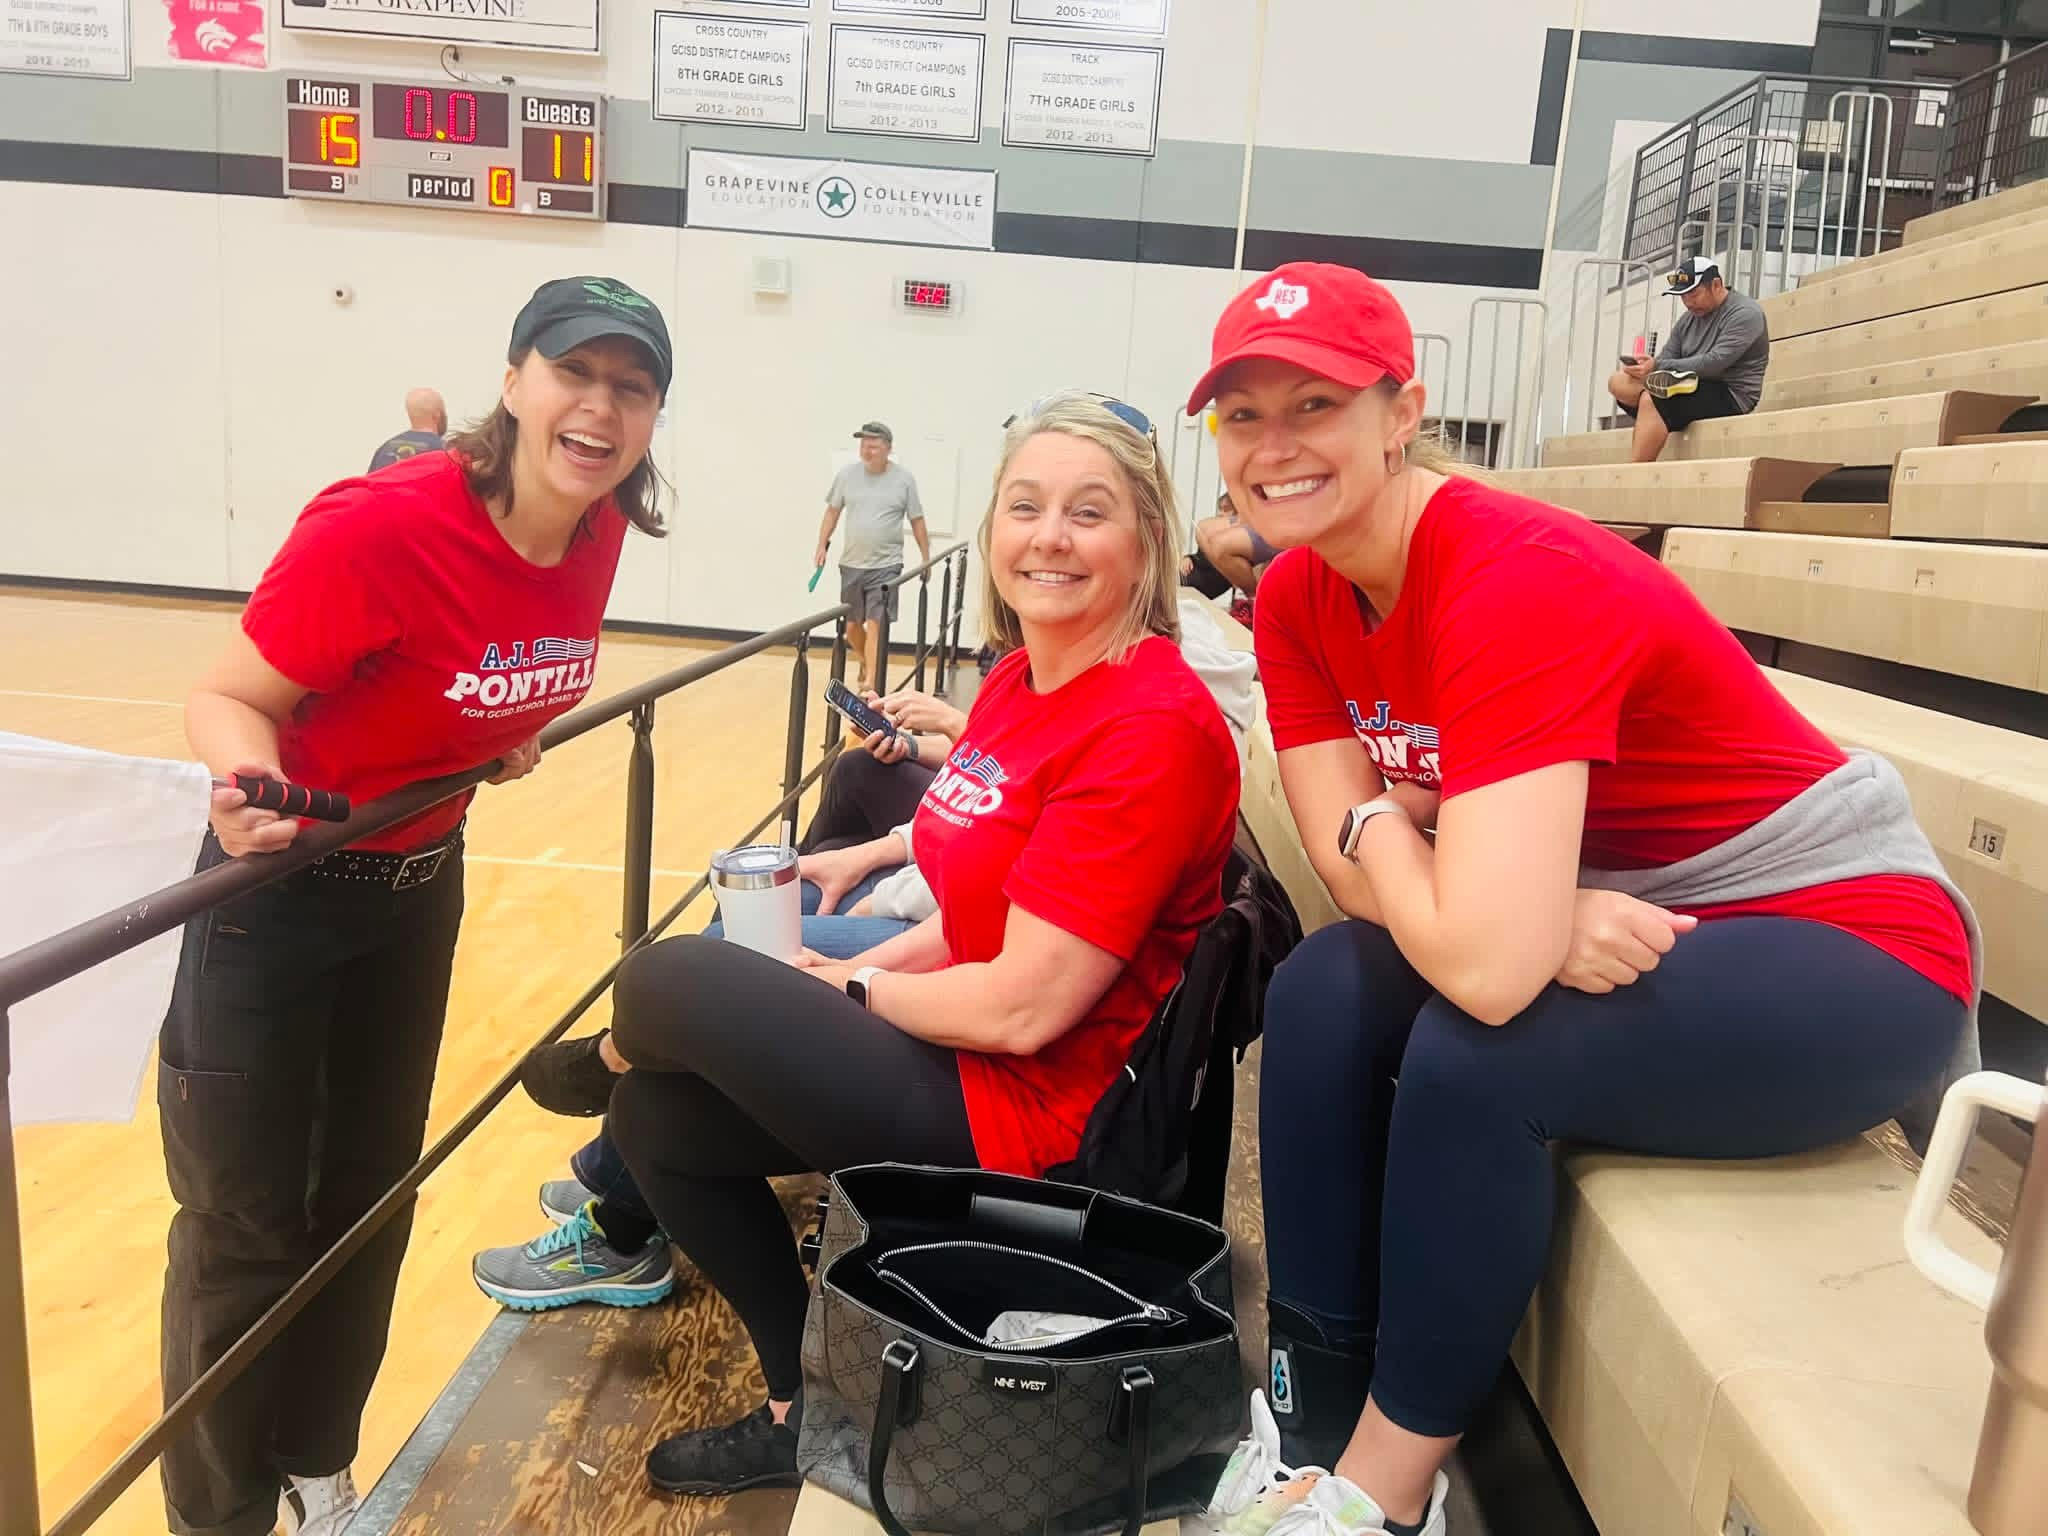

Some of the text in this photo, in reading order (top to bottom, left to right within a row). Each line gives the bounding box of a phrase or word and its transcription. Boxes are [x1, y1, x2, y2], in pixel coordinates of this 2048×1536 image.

[696, 25, 768, 40] CROSS COUNTRY
[672, 44, 791, 64] GCISD DISTRICT CHAMPIONS
[903, 40, 944, 52] COUNTRY
[847, 57, 872, 69] GCISD
[916, 62, 966, 76] CHAMPIONS
[1072, 54, 1100, 65] TRACK
[678, 68, 784, 86] 8TH GRADE GIRLS
[298, 79, 350, 107] Home
[855, 80, 956, 98] 7th GRADE GIRLS
[526, 98, 591, 125] Guests
[696, 103, 724, 114] 2012
[1029, 94, 1135, 112] 7TH GRADE GIRLS
[405, 88, 477, 144] 0.0
[870, 115, 898, 126] 2012
[910, 118, 938, 128] 2013
[320, 115, 358, 166] 15
[1045, 129, 1074, 141] 2012
[1085, 132, 1113, 144] 2013
[554, 134, 592, 182] 11
[331, 176, 343, 189] B
[412, 178, 471, 198] period
[491, 168, 512, 206] 0
[706, 175, 984, 208] GRAPEVINE COLLEYVILLE
[540, 192, 551, 205] B
[711, 192, 975, 222] EDUCATION FOUNDATION
[480, 642, 530, 670] A.J.
[460, 707, 485, 718] FOR
[1982, 834, 1997, 853] 15
[994, 1376, 1047, 1392] NINE WEST
